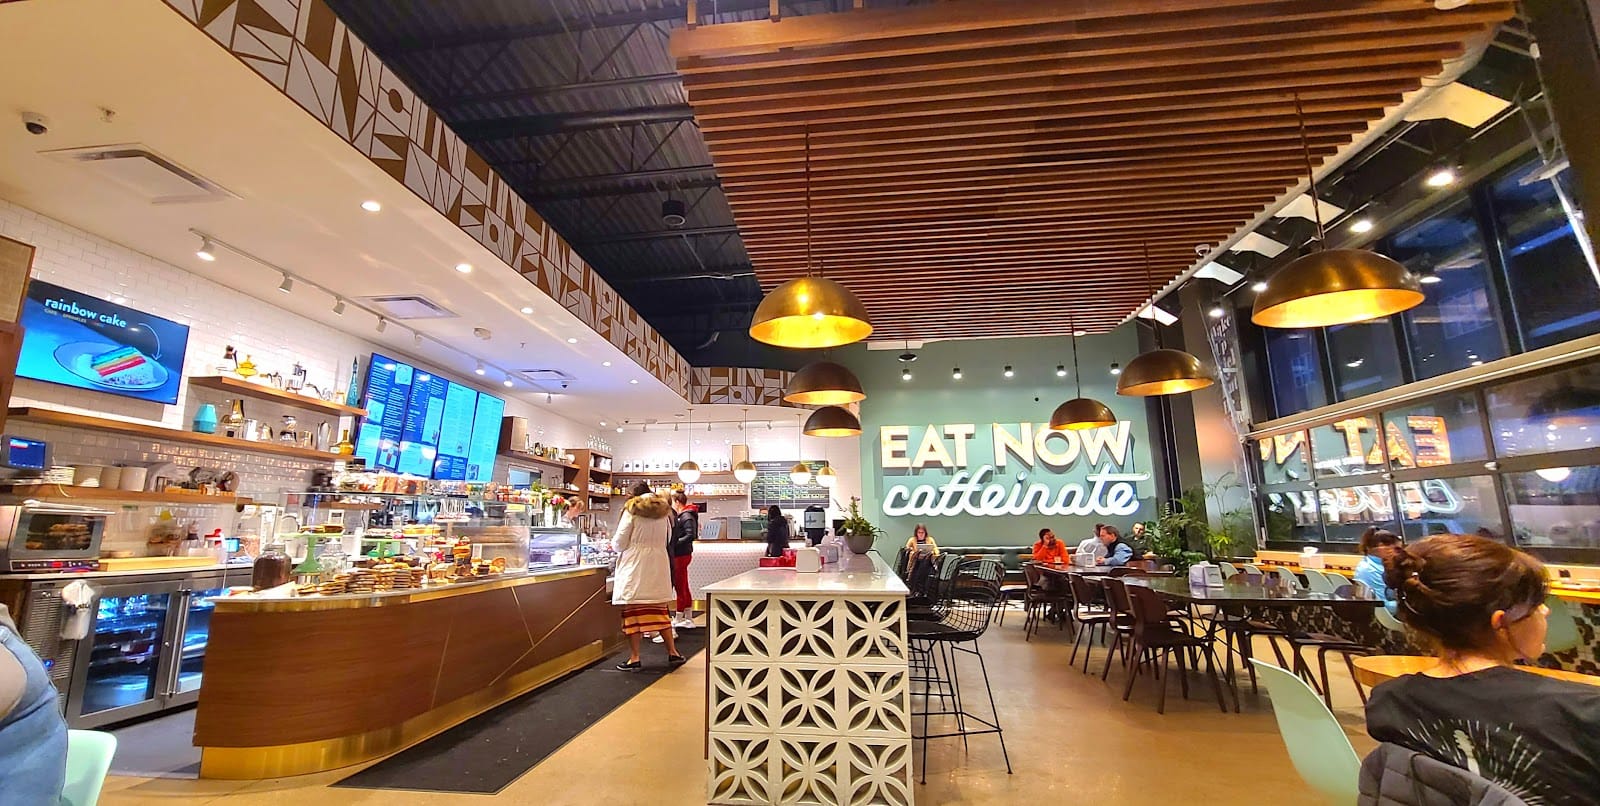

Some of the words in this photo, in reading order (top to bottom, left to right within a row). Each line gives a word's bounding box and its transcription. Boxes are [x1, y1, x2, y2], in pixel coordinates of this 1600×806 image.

[44, 298, 97, 319] rainbow
[99, 314, 127, 328] cake
[880, 423, 976, 469] EAT
[992, 420, 1132, 470] NOW
[882, 462, 1151, 517] caffeinate
